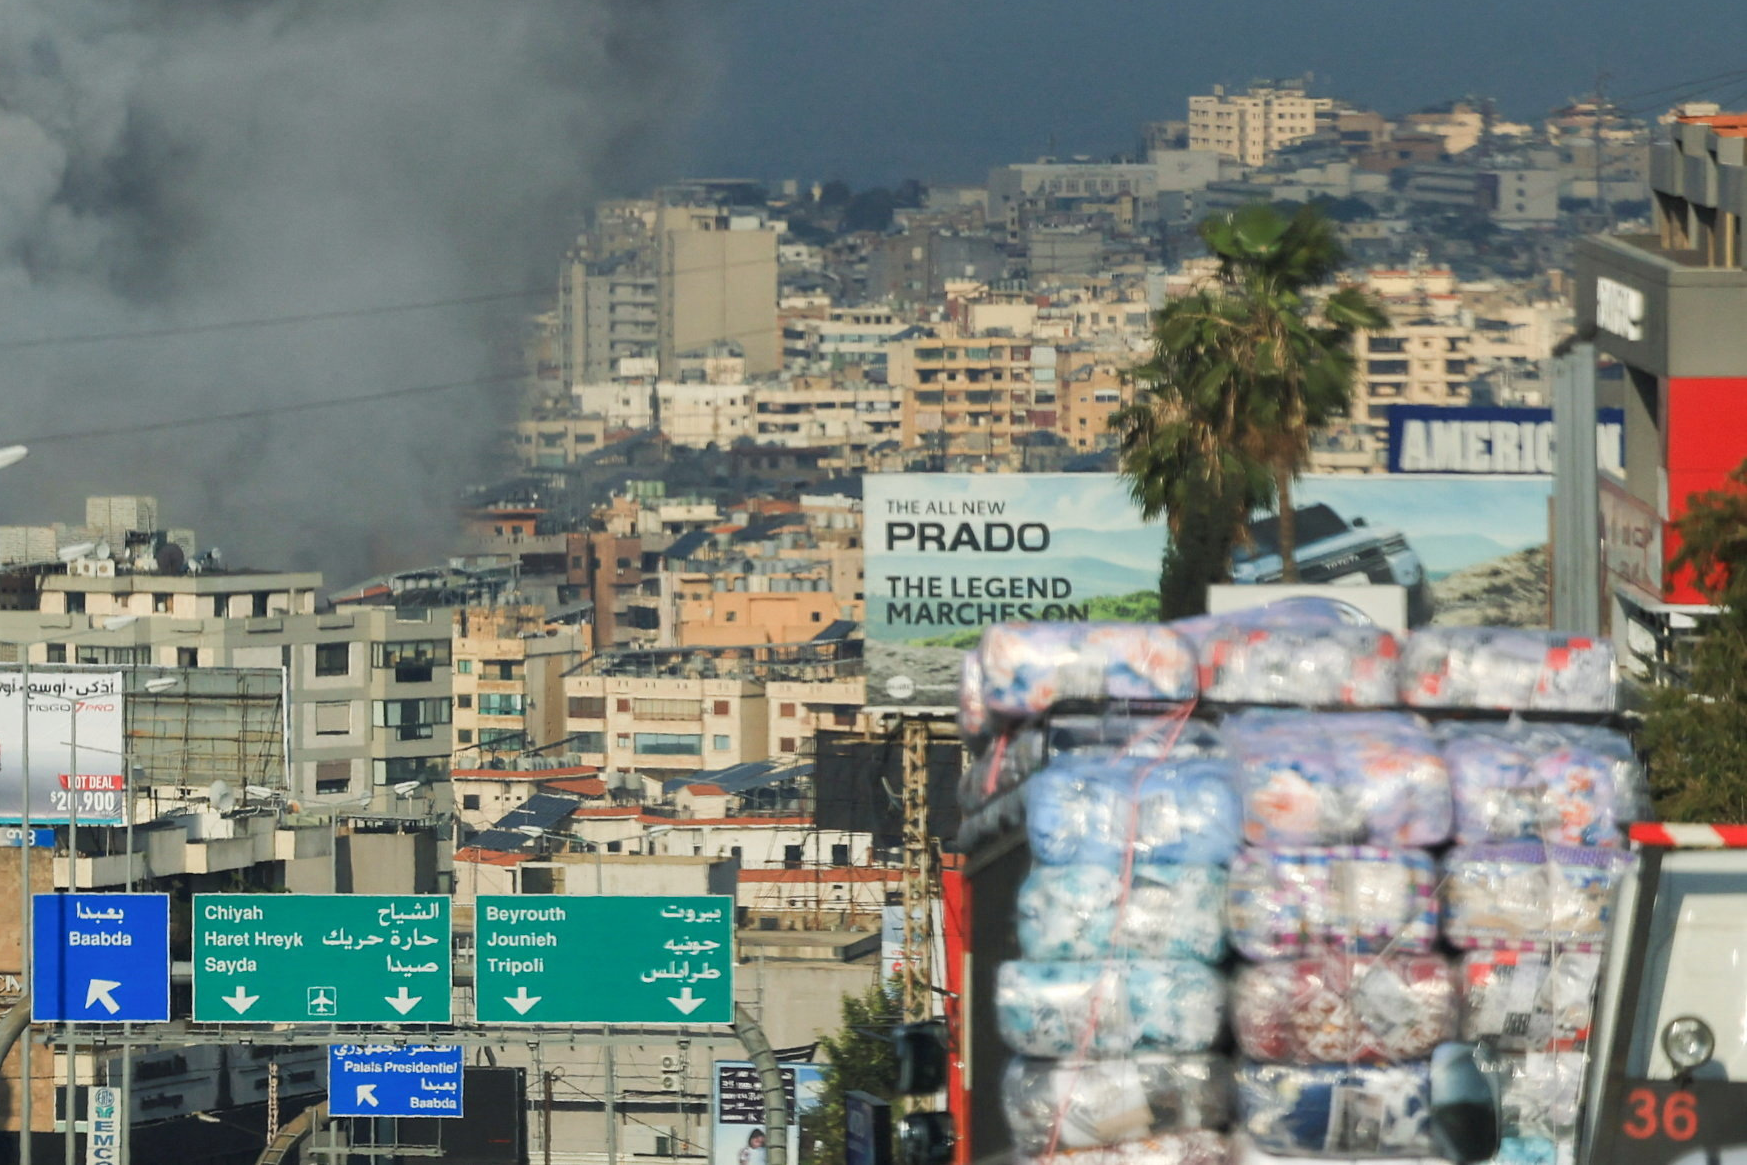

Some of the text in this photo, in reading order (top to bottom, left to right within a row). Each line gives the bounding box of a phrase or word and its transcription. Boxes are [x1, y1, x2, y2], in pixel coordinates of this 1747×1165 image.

[1398, 419, 1623, 474] AMERICN
[885, 499, 1006, 515] THE ALL NEW
[885, 521, 1051, 553] PRADO
[885, 576, 1072, 599] THE LEGEND
[885, 602, 1090, 625] MARCHES ON
[89, 776, 115, 789] DEAL
[76, 901, 124, 925] بعبدا
[204, 905, 264, 921] Chiyah
[377, 902, 439, 926] الشياح
[486, 906, 566, 925] Beyrouth
[660, 904, 722, 923] بيروت
[69, 930, 132, 946] Baabda
[204, 931, 304, 950] Haret Hreyk
[322, 927, 439, 951] حارة حريك
[486, 932, 558, 947] Jounieh
[204, 956, 257, 975] Sayda
[386, 954, 439, 977] صيدا
[486, 958, 545, 976] Tripoli
[640, 960, 722, 983] طرابلس
[344, 1061, 458, 1074] Palais Presidentiel
[421, 1077, 458, 1095] بعبدا
[410, 1097, 457, 1110] Baabda
[1623, 1088, 1699, 1142] 36
